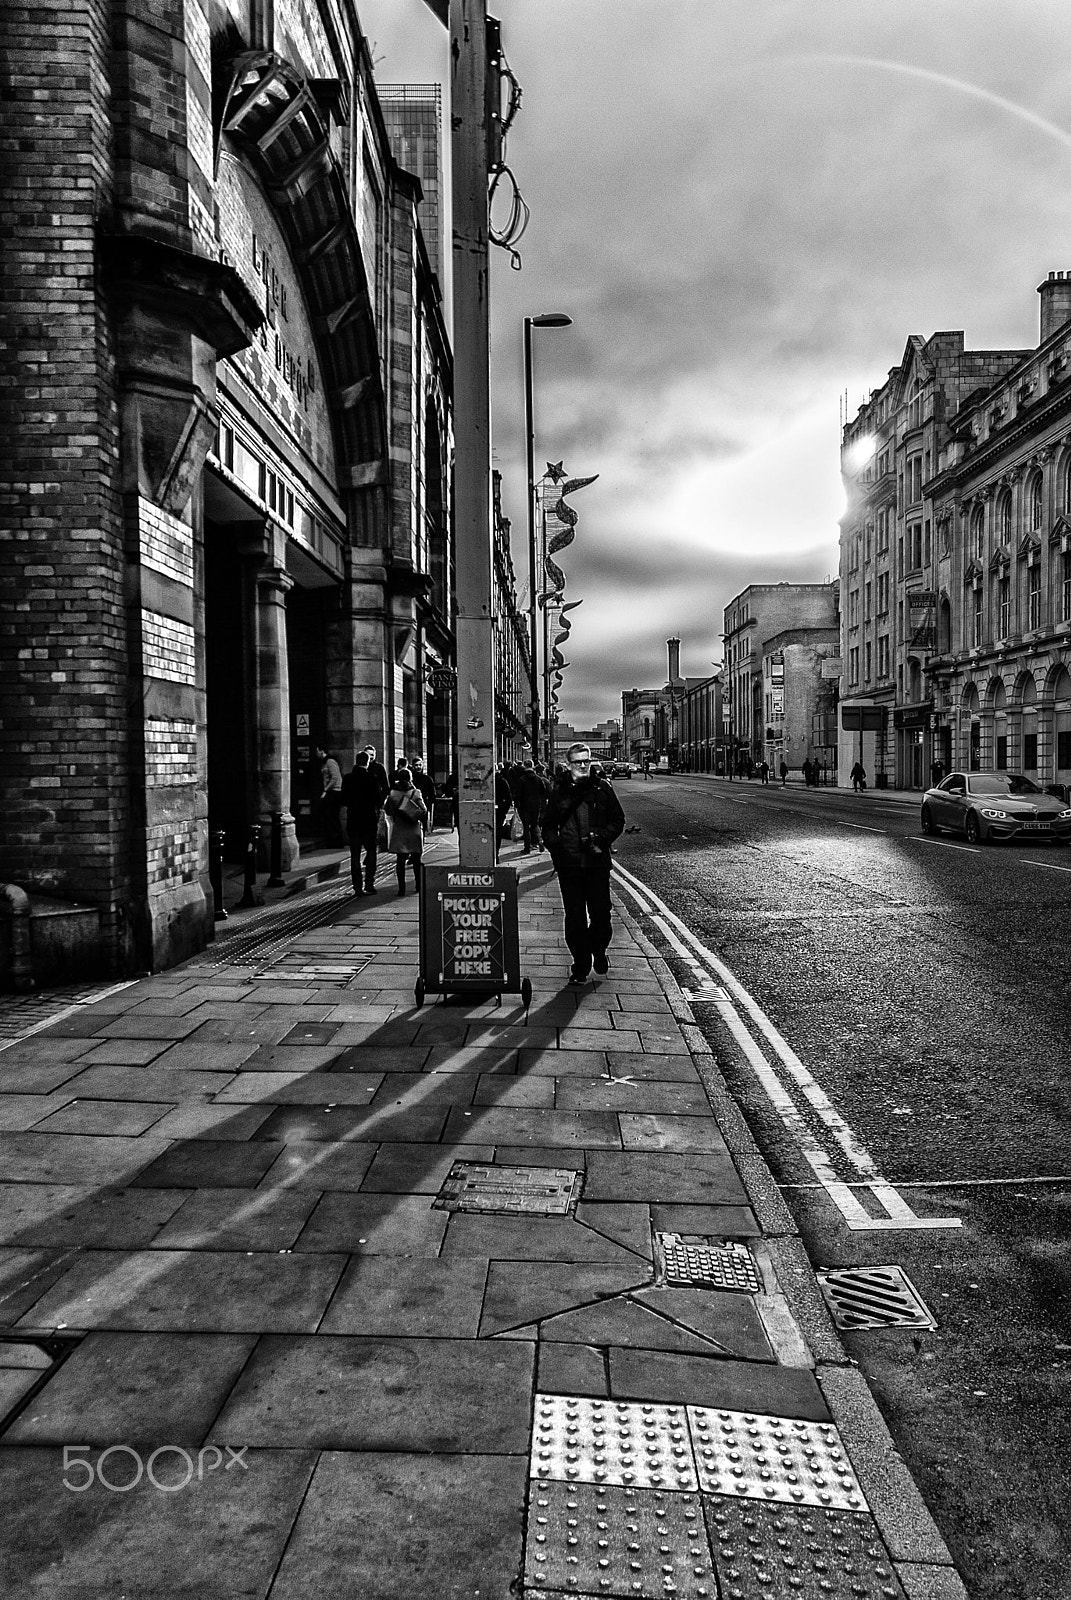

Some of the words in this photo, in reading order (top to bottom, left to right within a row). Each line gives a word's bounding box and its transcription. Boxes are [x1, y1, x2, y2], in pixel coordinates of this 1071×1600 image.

[450, 874, 493, 886] METRO
[444, 898, 476, 911] PICK
[478, 898, 499, 911] UP
[452, 914, 492, 927] YOUR
[455, 929, 489, 943] FREE
[453, 945, 491, 959] COPY
[454, 961, 492, 975] HERE
